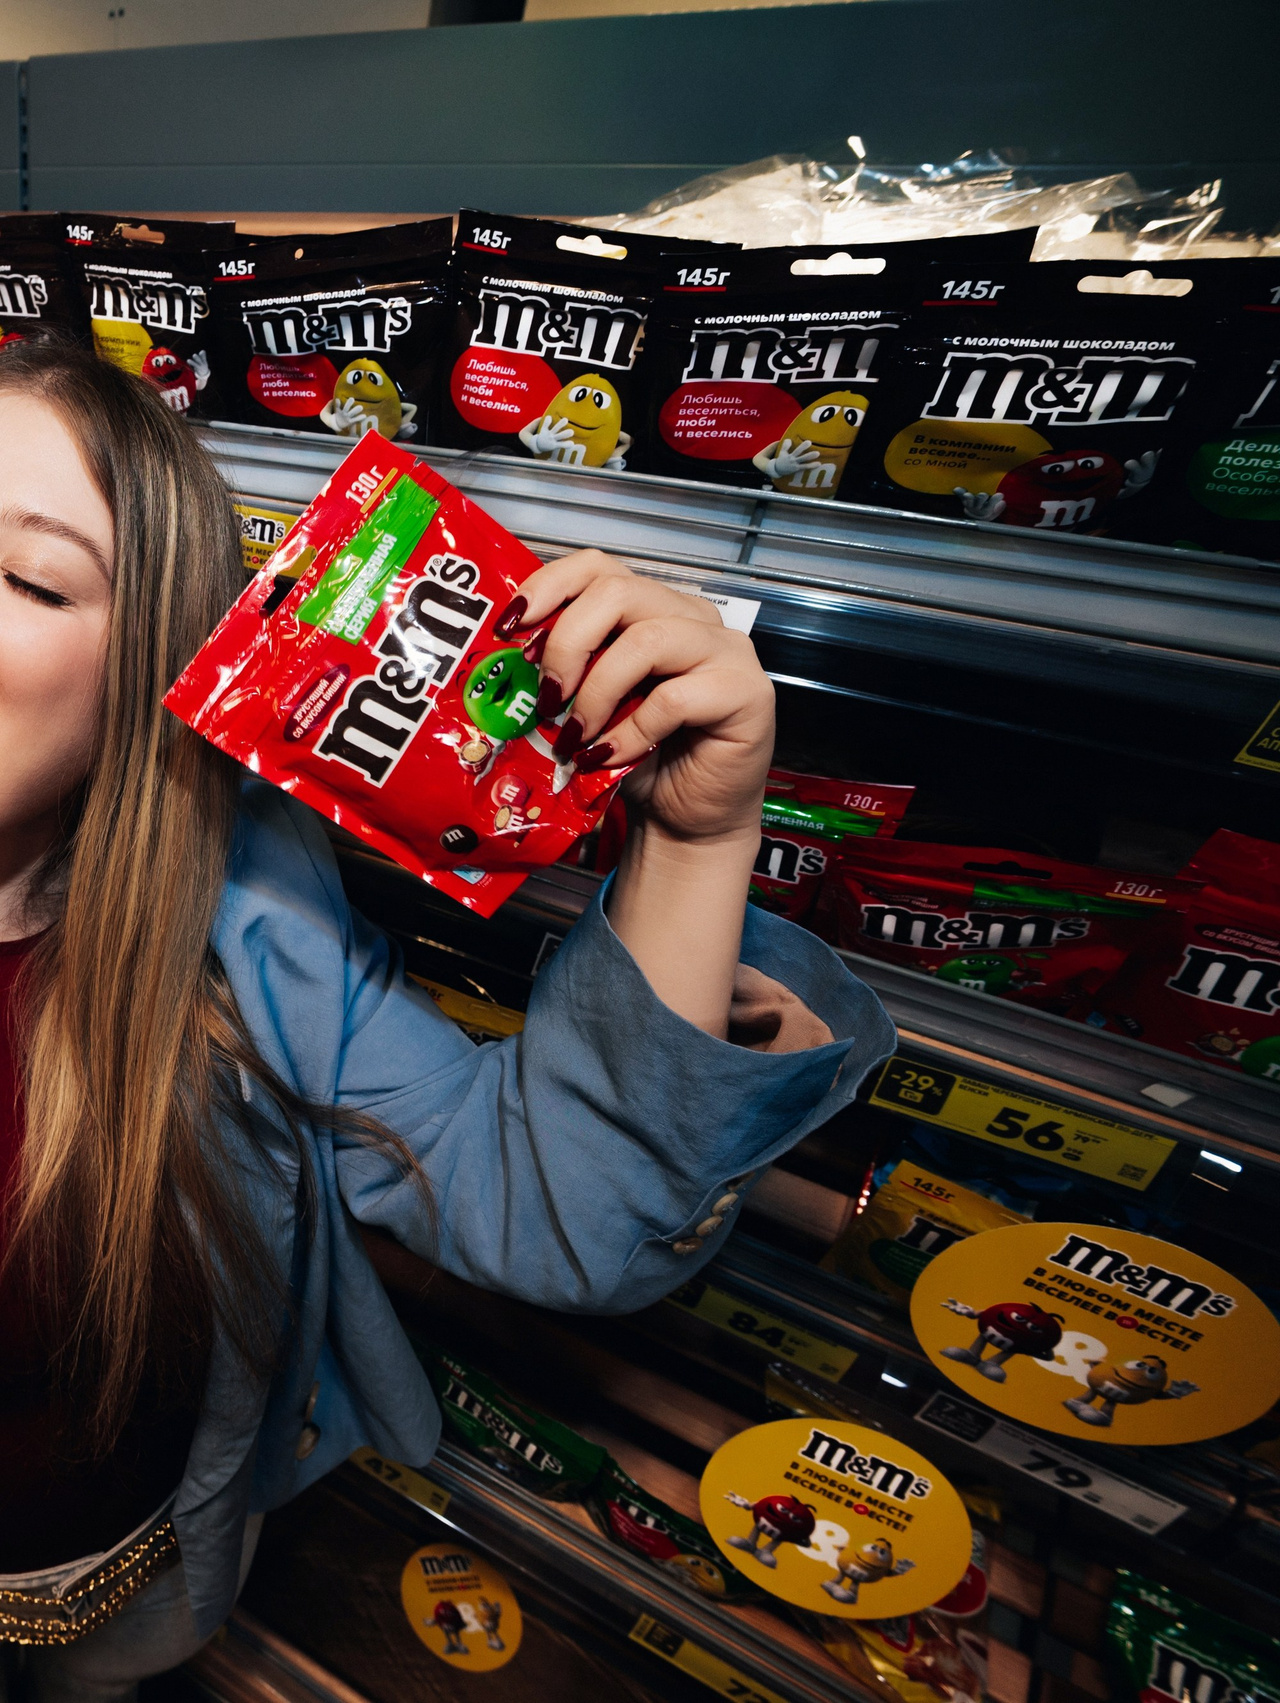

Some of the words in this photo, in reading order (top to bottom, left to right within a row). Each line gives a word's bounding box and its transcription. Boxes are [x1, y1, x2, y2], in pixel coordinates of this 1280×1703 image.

[66, 224, 94, 241] 145г
[472, 227, 512, 250] 145г
[218, 259, 256, 276] 145г
[676, 268, 730, 286] 145г
[489, 276, 551, 293] молочным
[941, 280, 1005, 299] 145г
[242, 297, 412, 357] m&m's
[704, 313, 785, 325] молочным
[788, 310, 882, 322] шоколадом
[964, 336, 1059, 349] молочным
[1062, 339, 1175, 351] шоколадом
[467, 358, 516, 376] Любишь
[463, 383, 493, 397] люби
[465, 373, 529, 392] веселиться,
[272, 390, 317, 398] веселись
[681, 394, 743, 405] Любишь
[469, 396, 521, 414] веселись
[678, 407, 761, 418] веселиться,
[676, 418, 716, 427] люби
[674, 430, 683, 438] и
[686, 429, 753, 439] веселись
[913, 435, 925, 444] В
[929, 437, 1017, 454] компании
[903, 458, 922, 467] со
[925, 457, 968, 469] мной
[1212, 467, 1280, 483] Особе
[1035, 497, 1096, 528] m
[236, 512, 286, 546] &m's
[343, 597, 378, 640] СЕРИЯ
[312, 552, 494, 788] m&m's
[292, 727, 304, 738] СО
[300, 699, 326, 729] ВКУСОМ
[322, 671, 347, 701] ВИШНИ
[293, 678, 329, 722] ХРУСТЯЩИЙ
[504, 689, 538, 726] m
[500, 783, 520, 803] m
[444, 827, 465, 843] m
[858, 903, 1092, 951] m&m's
[985, 1106, 1065, 1151] 56
[913, 1177, 955, 1200] 145г
[1046, 1232, 1237, 1320] m&m's
[1023, 1277, 1108, 1315] ВЕСЕЛЕЕ
[1032, 1266, 1045, 1277] В
[1048, 1273, 1131, 1311] ЛЮБОМ
[1134, 1307, 1204, 1342] МЕСТЕ
[728, 1311, 786, 1347] 84
[797, 1427, 933, 1503] m&m's
[1021, 1450, 1092, 1488] 79
[783, 1471, 842, 1504] ВЕСЕЛЕЕ
[790, 1461, 799, 1470] В
[802, 1467, 862, 1499] ЛЮБОМ
[865, 1496, 914, 1523] МЕСТЕ
